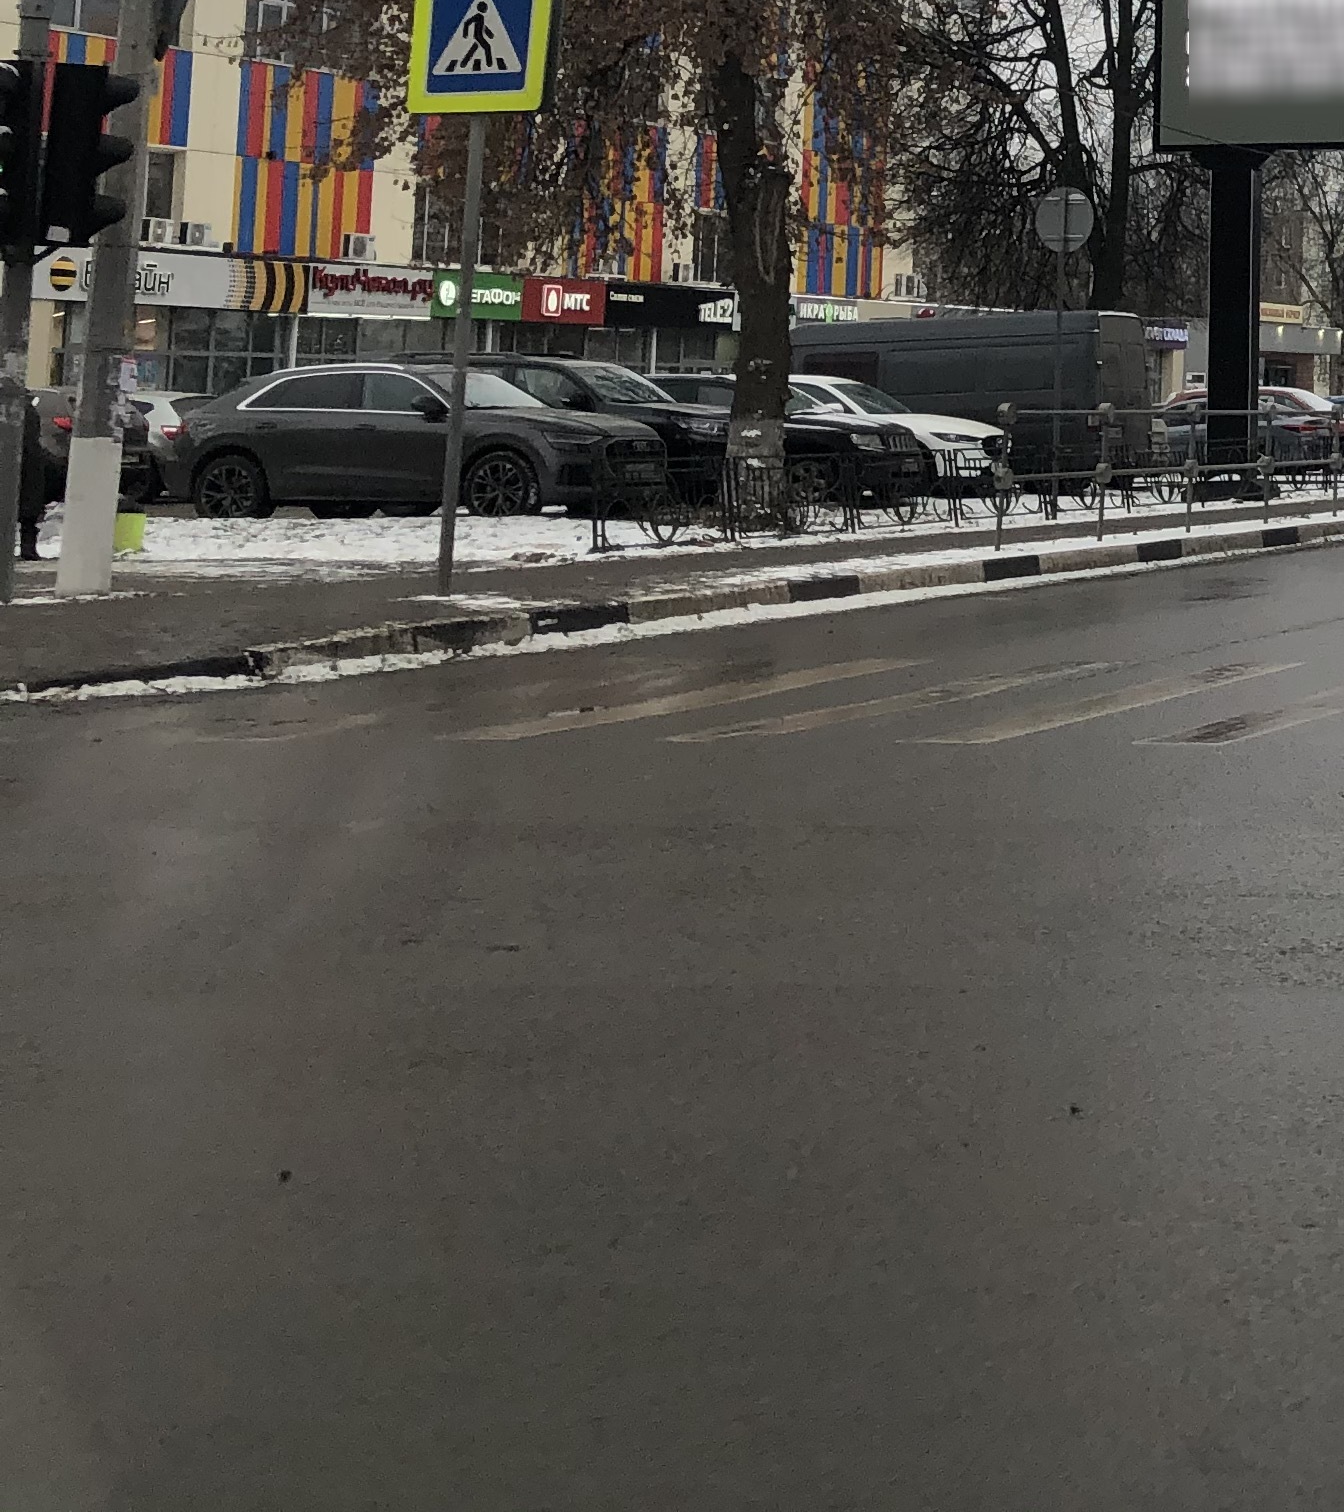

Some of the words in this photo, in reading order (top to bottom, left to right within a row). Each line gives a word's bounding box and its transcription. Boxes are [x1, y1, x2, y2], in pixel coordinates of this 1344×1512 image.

[470, 288, 521, 305] ЕГАФОН
[563, 293, 590, 311] МТС
[699, 299, 733, 323] TELE2
[800, 302, 825, 319] ИКРА
[833, 306, 859, 321] РЫБА
